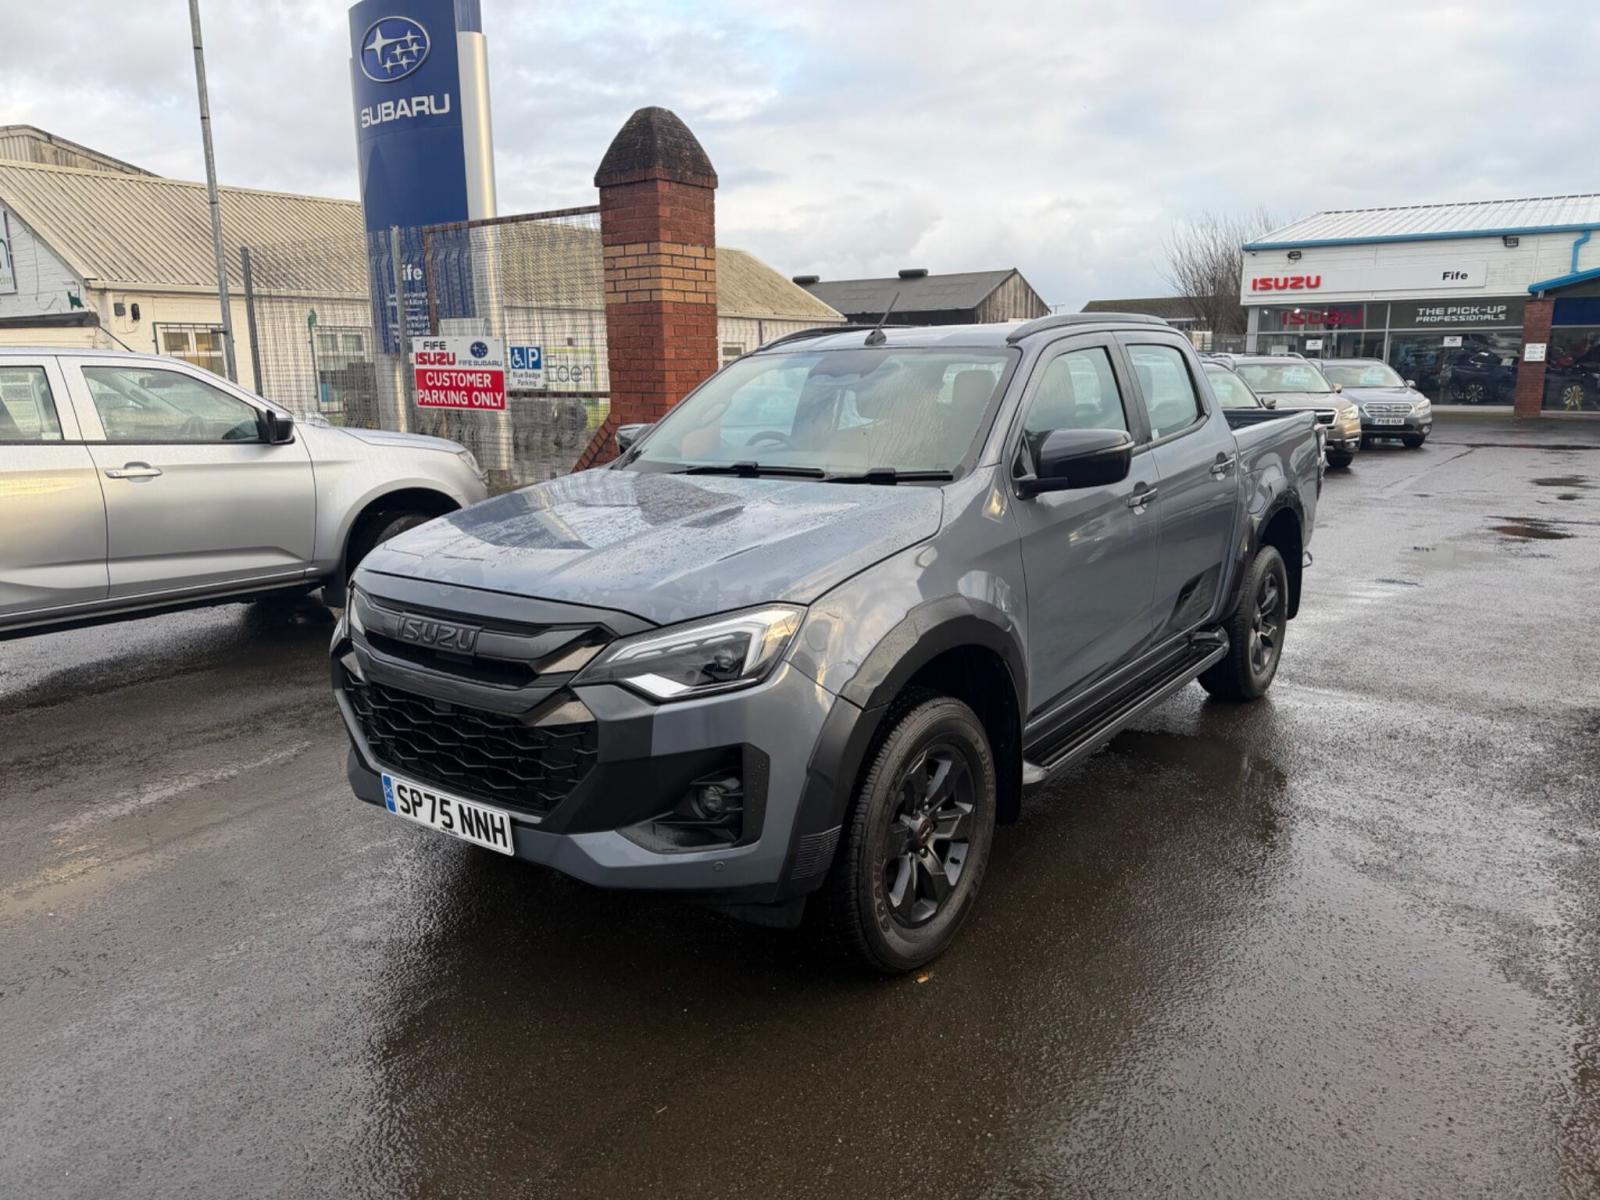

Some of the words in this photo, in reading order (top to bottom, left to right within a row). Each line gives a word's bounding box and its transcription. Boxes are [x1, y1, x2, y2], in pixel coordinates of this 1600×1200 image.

[361, 93, 450, 128] SUBARU
[401, 264, 423, 280] ife
[1442, 271, 1468, 280] Fife
[1252, 275, 1321, 291] ISUZU
[1282, 306, 1364, 325] ISUZU
[1415, 314, 1506, 323] PROFESSIONALS
[1417, 307, 1445, 316] THE
[1447, 305, 1507, 315] PICK-UP
[423, 341, 447, 351] FIFE
[415, 352, 456, 366] ISUZU
[528, 348, 539, 368] P
[426, 372, 492, 388] CUSTOMER
[418, 389, 468, 405] PARKING
[472, 392, 503, 407] ONLY
[401, 617, 476, 651] ISUZU
[397, 784, 454, 830] SP75
[458, 803, 508, 849] NNH
